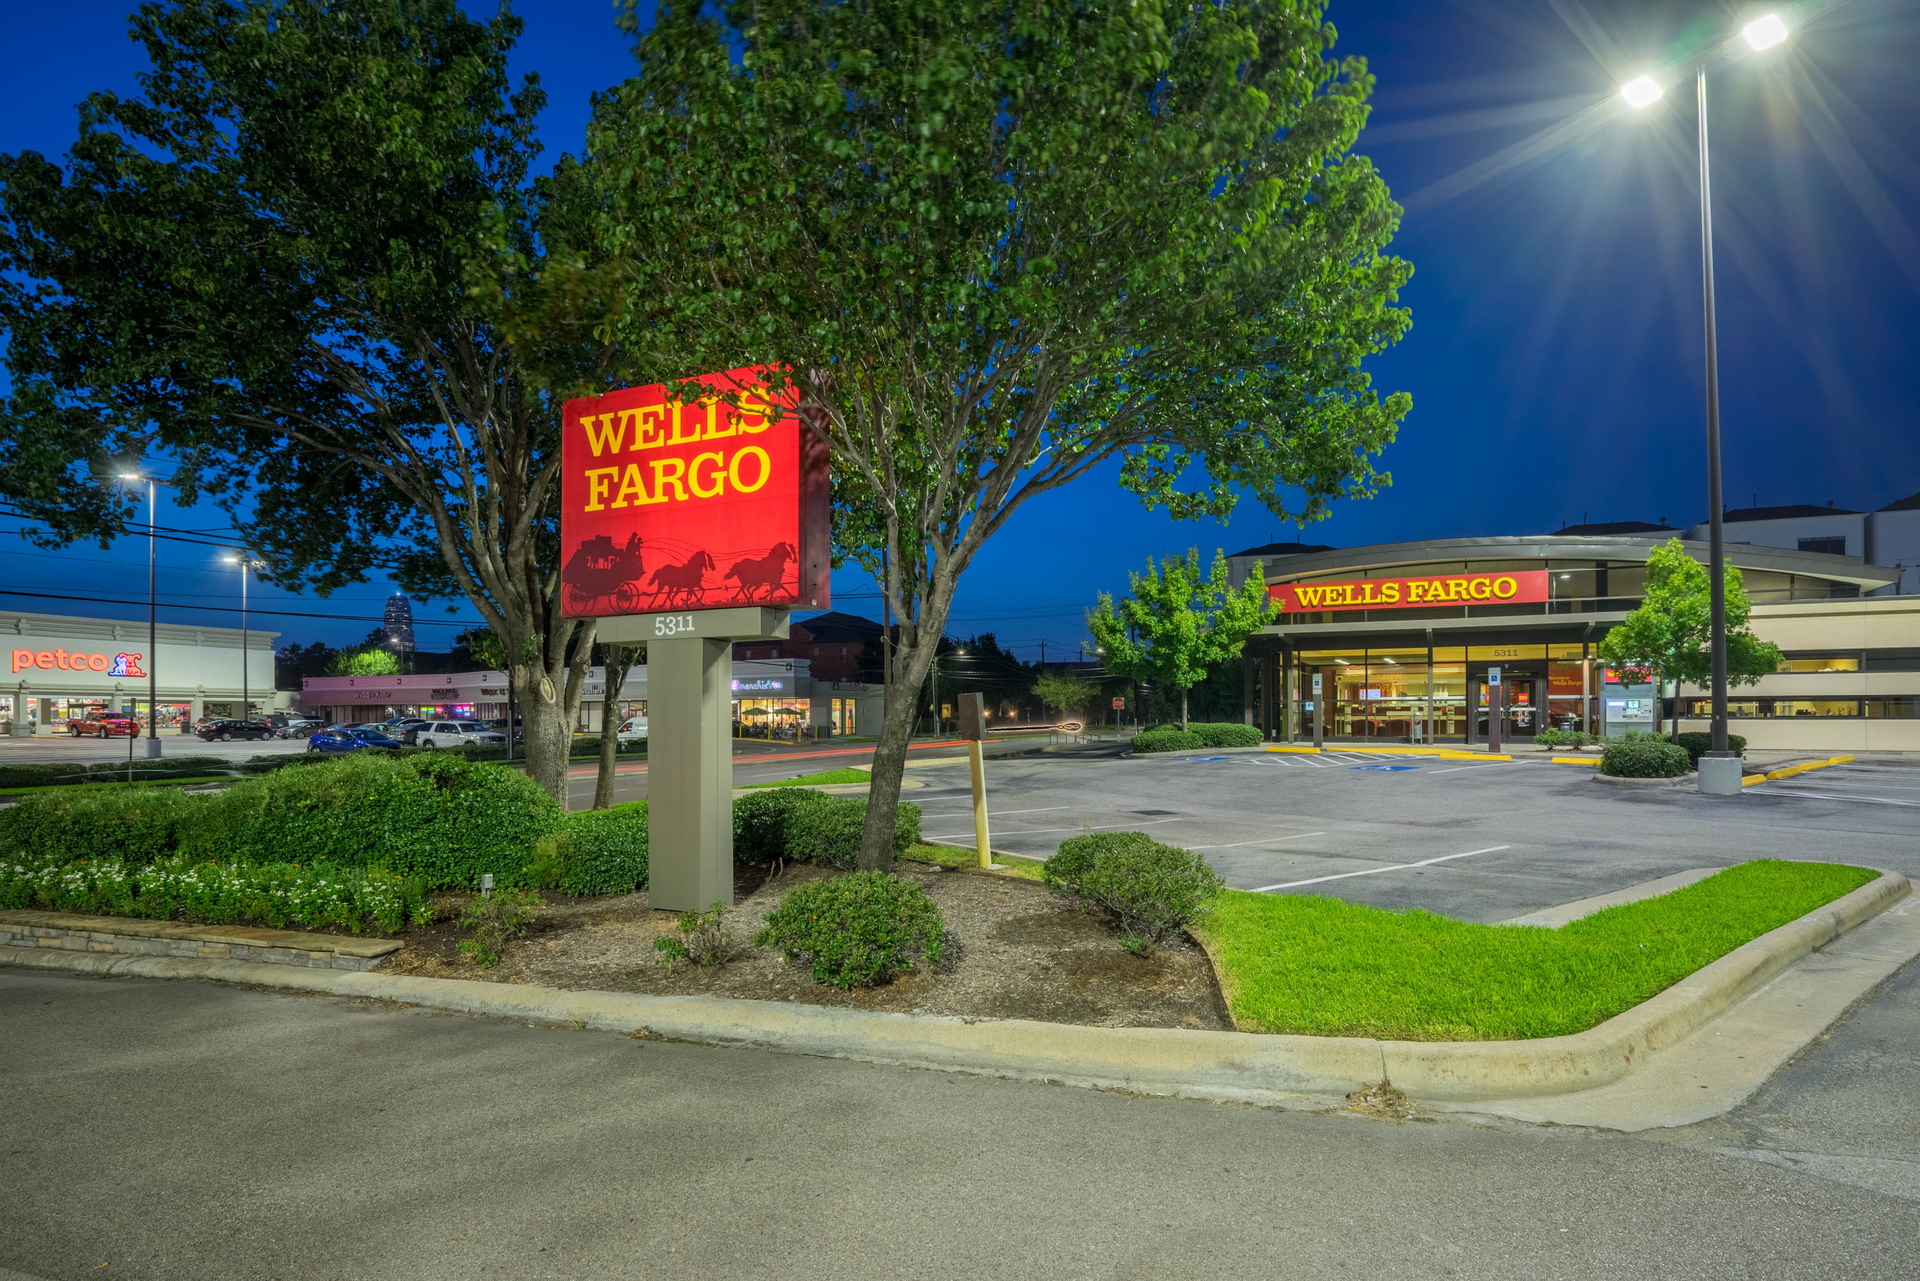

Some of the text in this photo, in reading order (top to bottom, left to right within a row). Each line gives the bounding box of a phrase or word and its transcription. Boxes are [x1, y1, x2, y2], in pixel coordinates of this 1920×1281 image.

[580, 387, 771, 457] WELLS
[584, 445, 771, 512] FARGO
[1294, 577, 1518, 607] WELLS FARGO
[655, 615, 695, 636] 5311
[12, 648, 110, 673] petco
[1494, 649, 1519, 657] 5311
